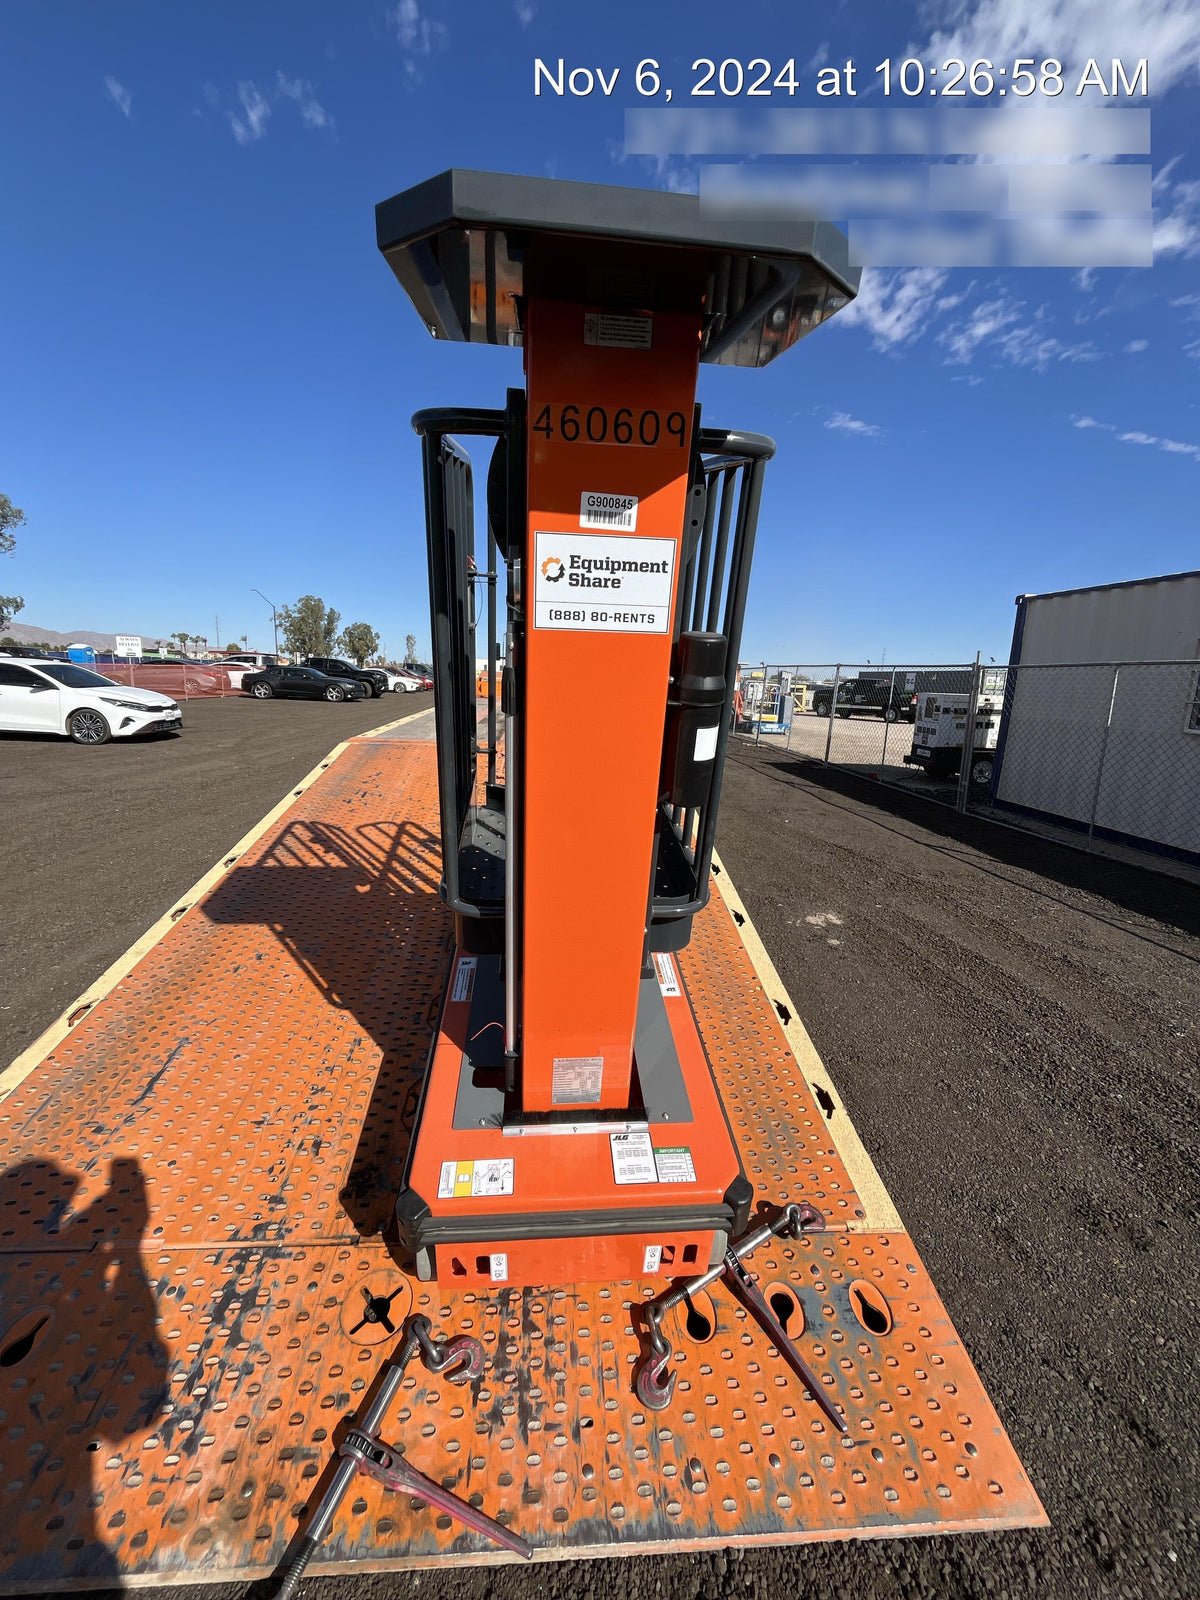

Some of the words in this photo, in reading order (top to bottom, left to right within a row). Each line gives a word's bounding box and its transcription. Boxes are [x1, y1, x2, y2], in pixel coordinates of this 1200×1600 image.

[532, 404, 686, 447] 460609
[587, 495, 633, 510] G900845
[569, 554, 669, 574] Equipment
[568, 572, 622, 589] Share
[549, 609, 586, 622] (888)
[590, 611, 656, 624] 80-RENTS
